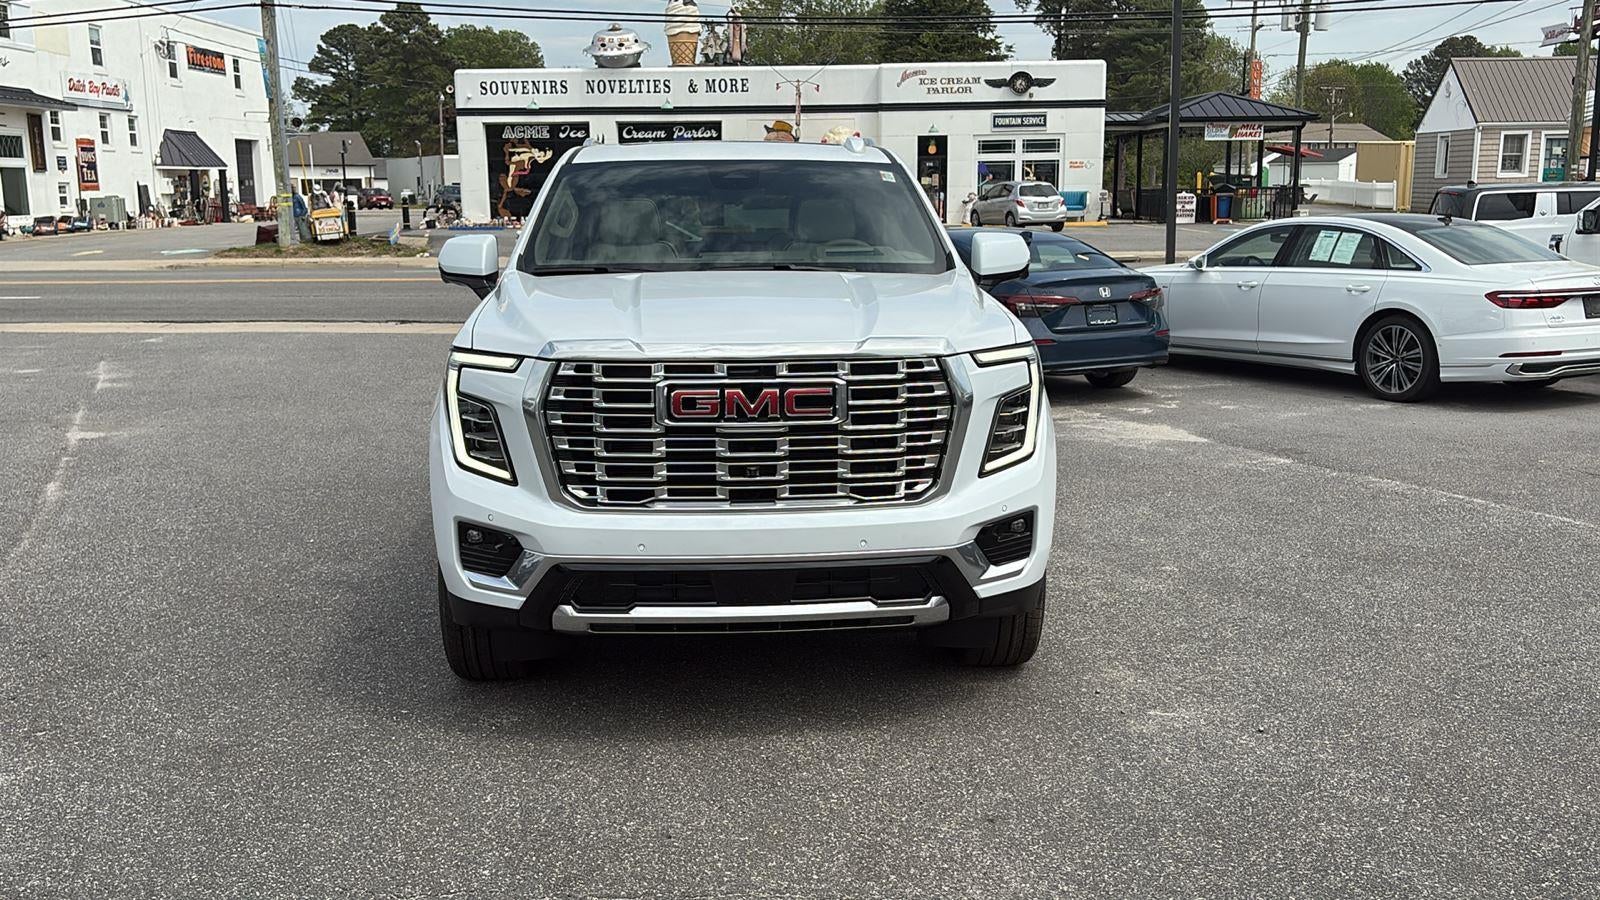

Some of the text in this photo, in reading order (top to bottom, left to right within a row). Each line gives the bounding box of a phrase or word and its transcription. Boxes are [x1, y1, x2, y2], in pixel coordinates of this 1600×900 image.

[68, 77, 120, 98] Dutch Boy Paints
[480, 78, 749, 95] SOUVENIRS NOVELTIES & MORE
[918, 77, 938, 86] ICE
[939, 76, 981, 85] CREAM
[926, 86, 973, 94] PARLOR
[994, 115, 1045, 126] FOUNTAIN SERVICE
[1241, 123, 1263, 131] MILK
[502, 125, 587, 139] ACME Ice
[622, 125, 718, 139] Cream Parlor
[82, 168, 96, 181] TEA
[671, 387, 833, 418] GMC
